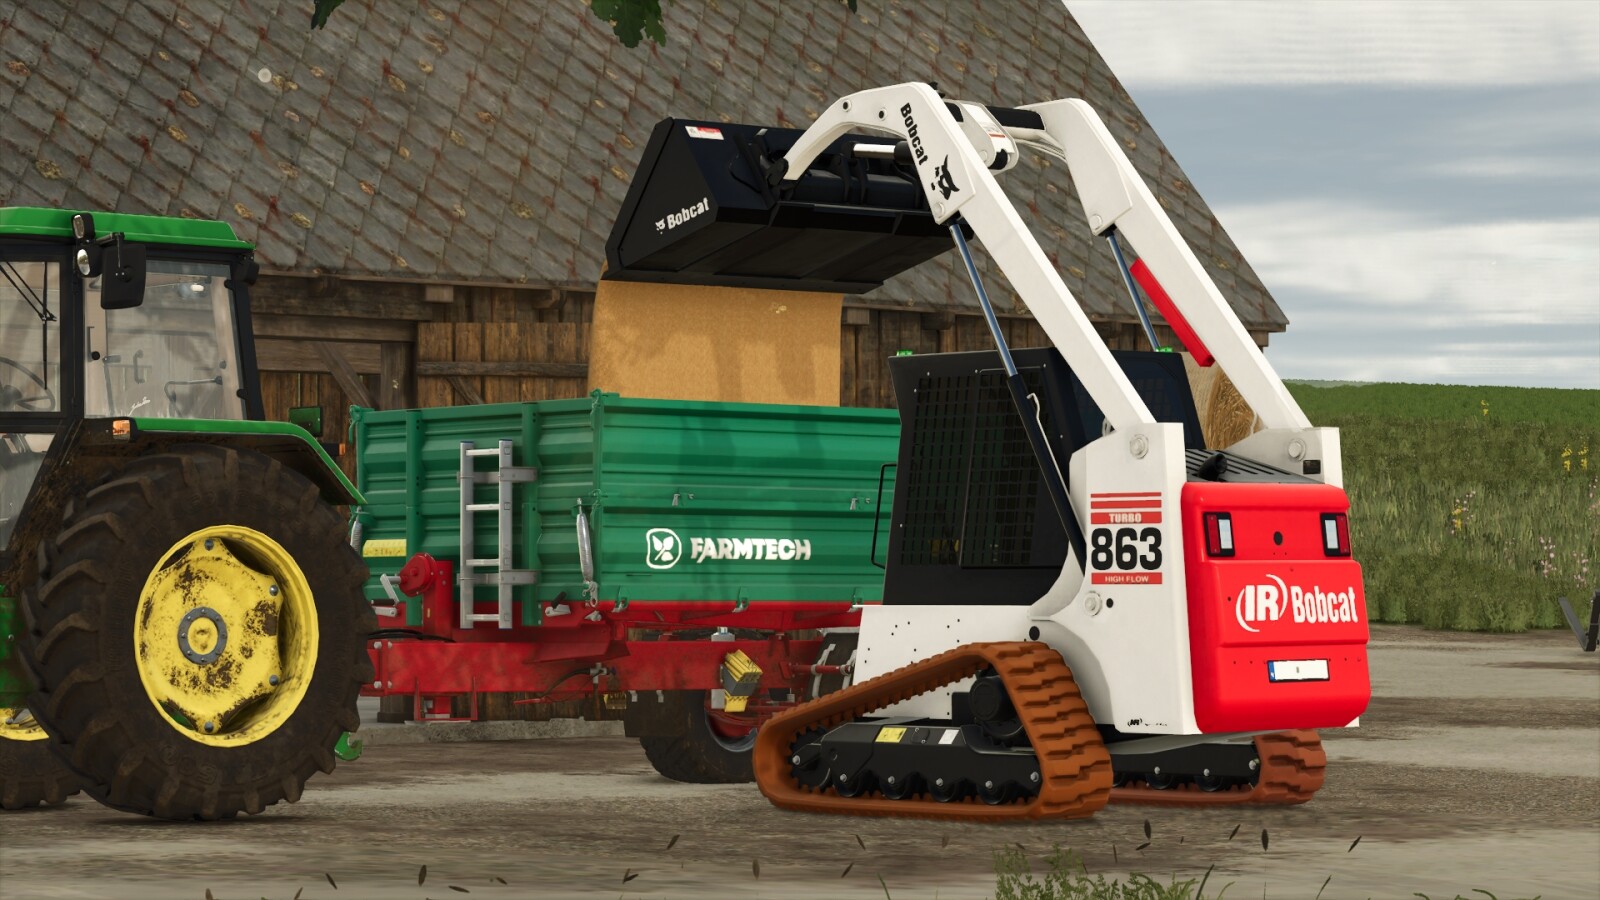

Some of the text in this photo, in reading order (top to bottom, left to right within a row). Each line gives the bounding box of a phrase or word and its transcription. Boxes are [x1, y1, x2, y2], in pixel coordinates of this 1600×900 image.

[900, 102, 928, 166] Bobcat
[666, 197, 710, 230] Bobcat
[1109, 512, 1142, 524] TURBO
[690, 538, 812, 563] FARMTECH
[1091, 527, 1162, 570] 863
[1104, 575, 1149, 583] HIGH FLOW
[1289, 585, 1359, 624] Bobcat
